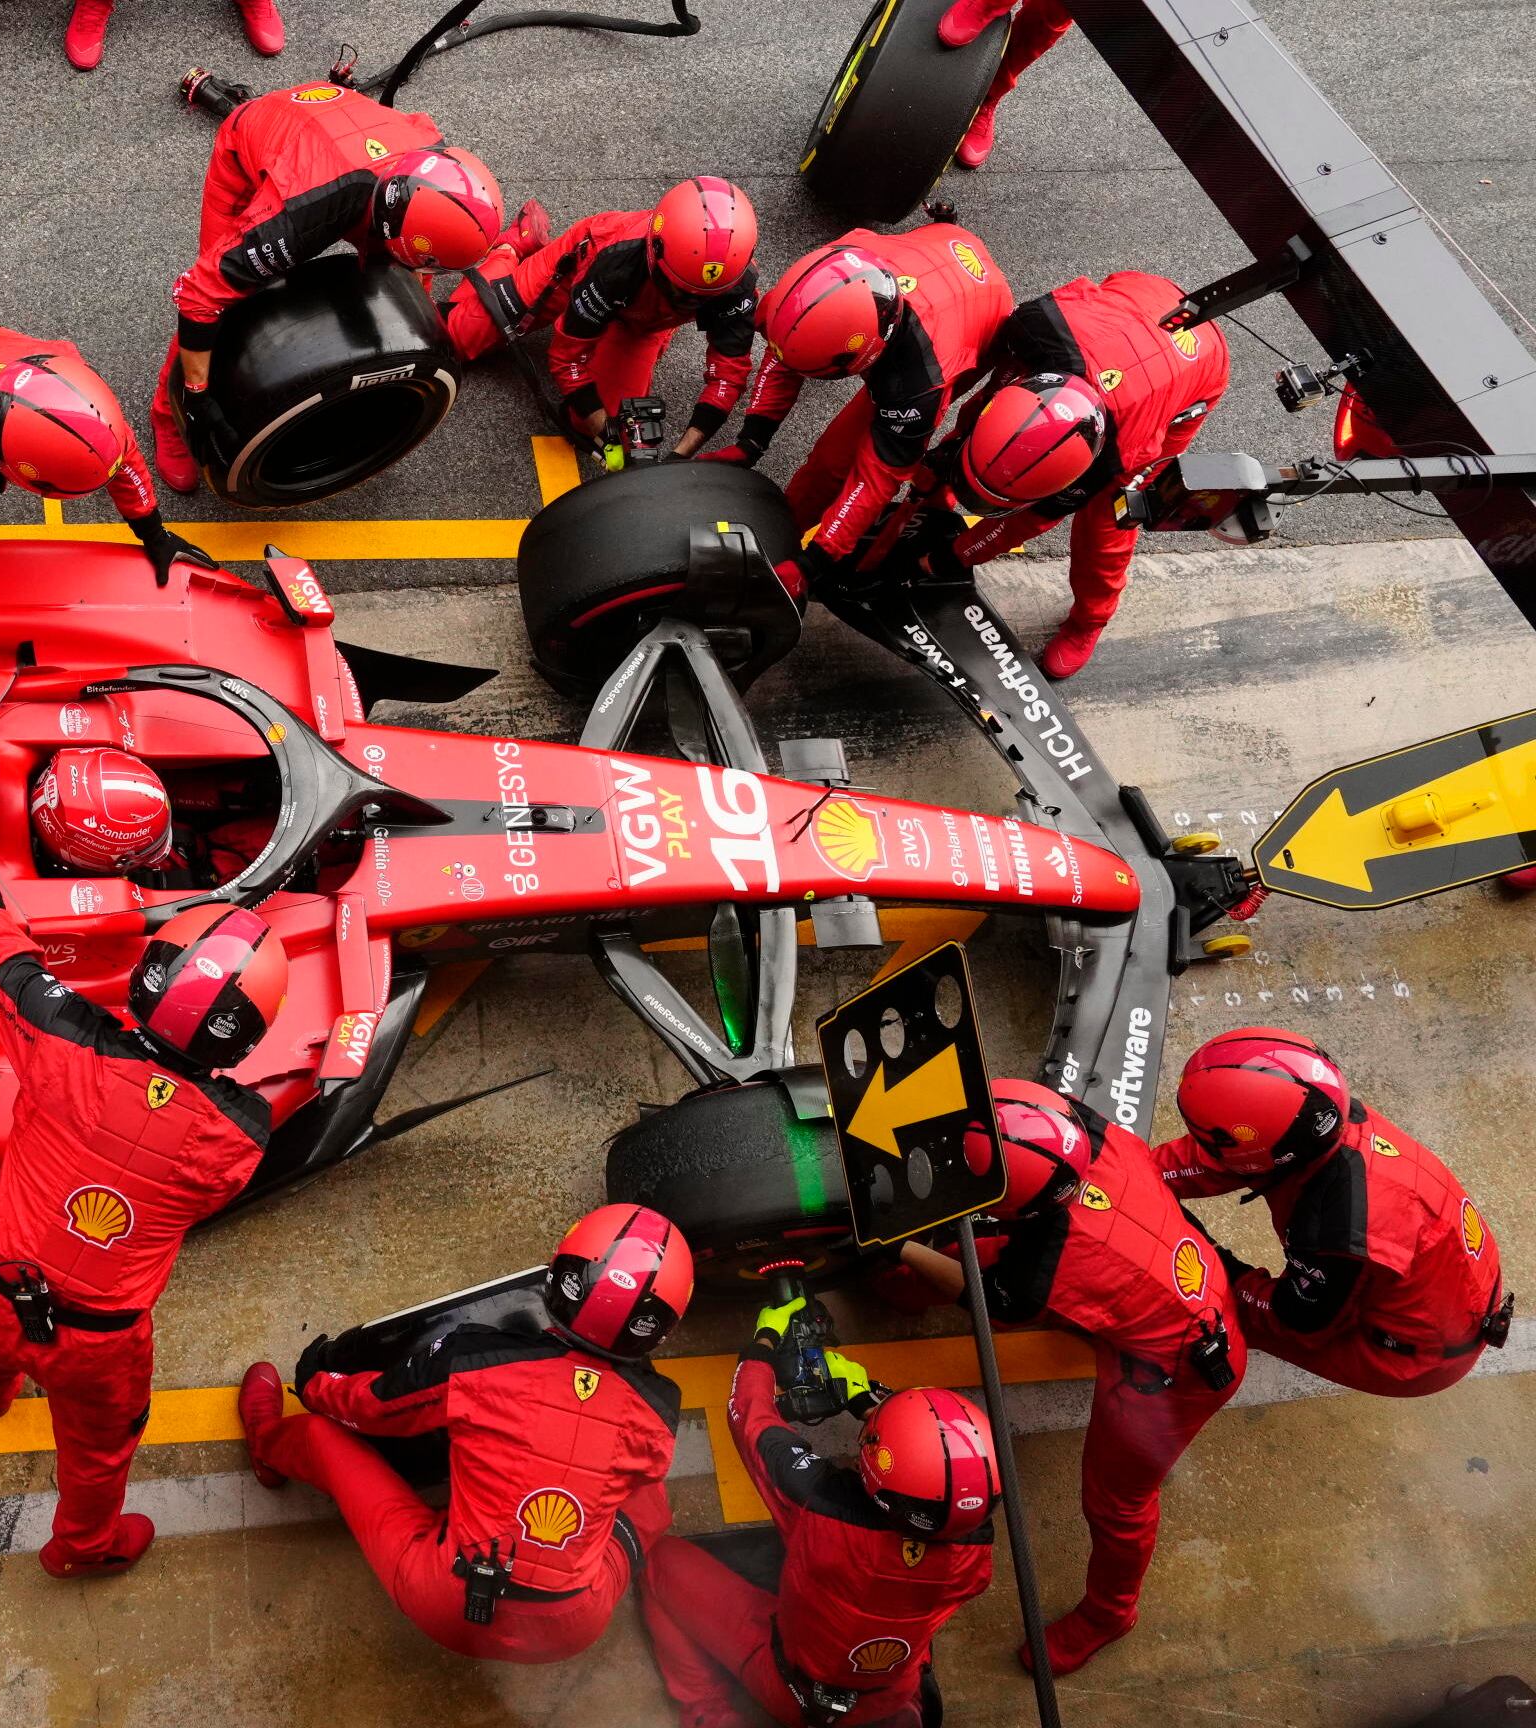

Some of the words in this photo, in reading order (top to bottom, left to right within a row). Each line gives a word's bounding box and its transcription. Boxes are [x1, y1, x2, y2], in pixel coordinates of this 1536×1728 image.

[350, 363, 416, 391] PIRELLI
[288, 584, 311, 609] PLAY
[296, 568, 332, 614] VGW
[86, 685, 137, 694] Bitdefender
[222, 677, 251, 700] aws
[598, 651, 646, 715] #WeRaceAsOne
[964, 604, 1093, 782] HCLSoftware
[46, 775, 56, 807] BELL
[493, 741, 537, 867] GENESYS
[97, 824, 153, 841] Santander
[609, 758, 667, 888] VGW
[657, 786, 692, 860] PLAY
[695, 766, 781, 893] 16
[897, 818, 921, 869] aws
[940, 810, 961, 868] Palantir
[240, 841, 276, 882] RICHARD
[373, 827, 390, 870] Galicia
[969, 814, 1000, 892] PIRELLI
[1003, 817, 1035, 897] MAHLE
[1060, 831, 1083, 905] Santande
[211, 876, 242, 898] MILLE
[341, 903, 352, 941] Riva
[199, 959, 220, 978] BELL
[337, 1015, 357, 1048] PLAY
[345, 1012, 377, 1067] VGW
[642, 994, 712, 1055] #WeRaceAsOne
[1110, 1006, 1153, 1134] oftware
[1180, 1167, 1205, 1178] MILL
[613, 1271, 633, 1288] BELL
[960, 1499, 980, 1507] BELL
